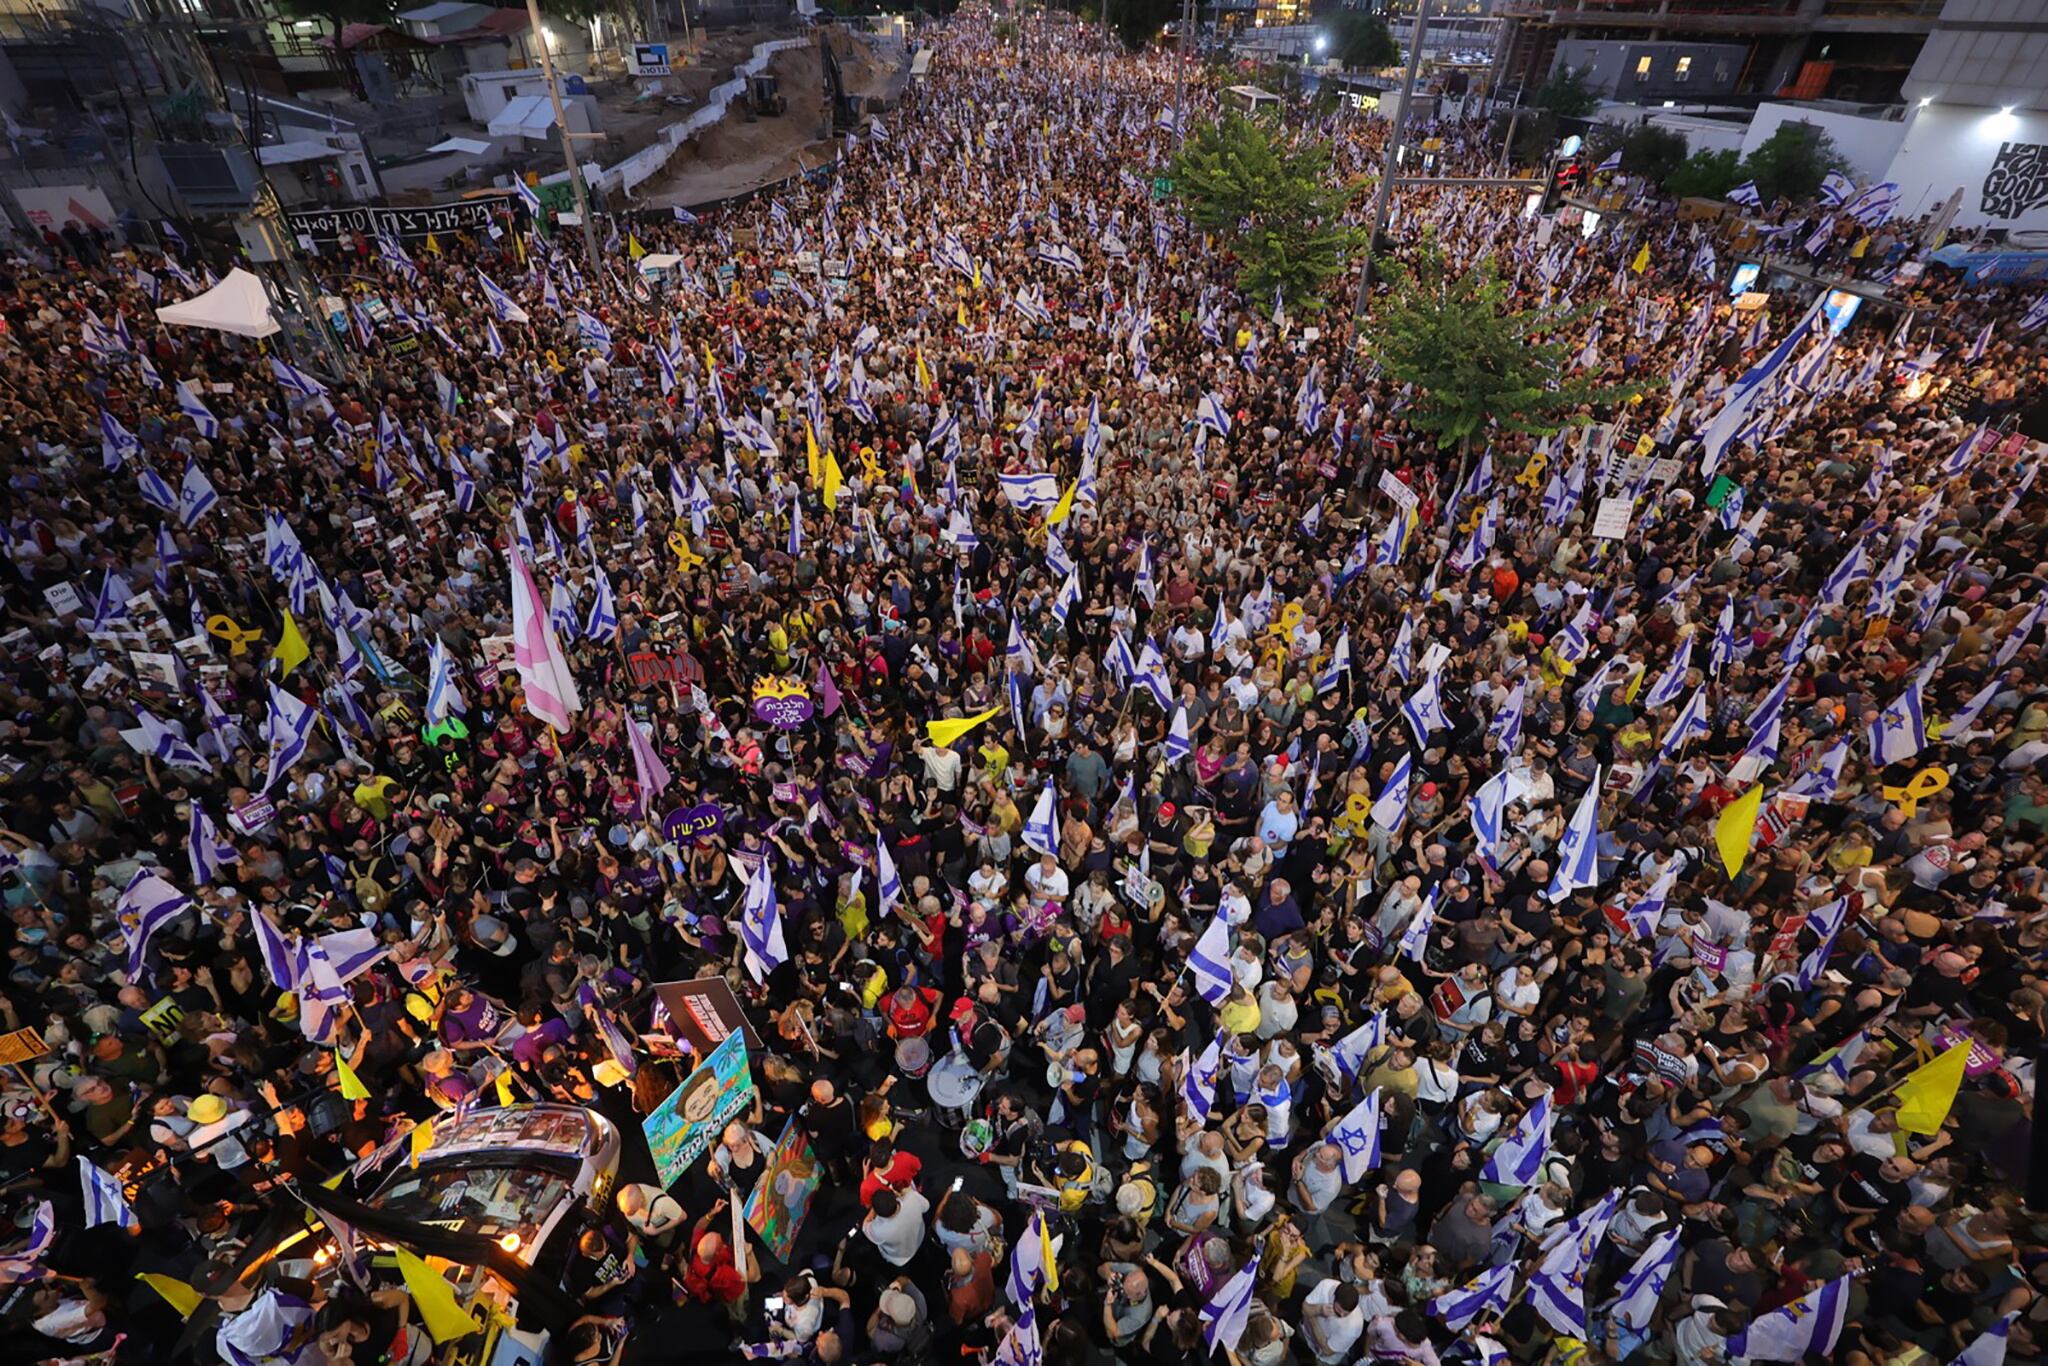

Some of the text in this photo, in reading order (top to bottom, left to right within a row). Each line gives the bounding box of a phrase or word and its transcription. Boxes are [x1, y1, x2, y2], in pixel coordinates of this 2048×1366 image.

[1983, 168, 2048, 202] GOOD
[1980, 195, 2034, 219] DAY
[672, 814, 717, 838] עכשיו
